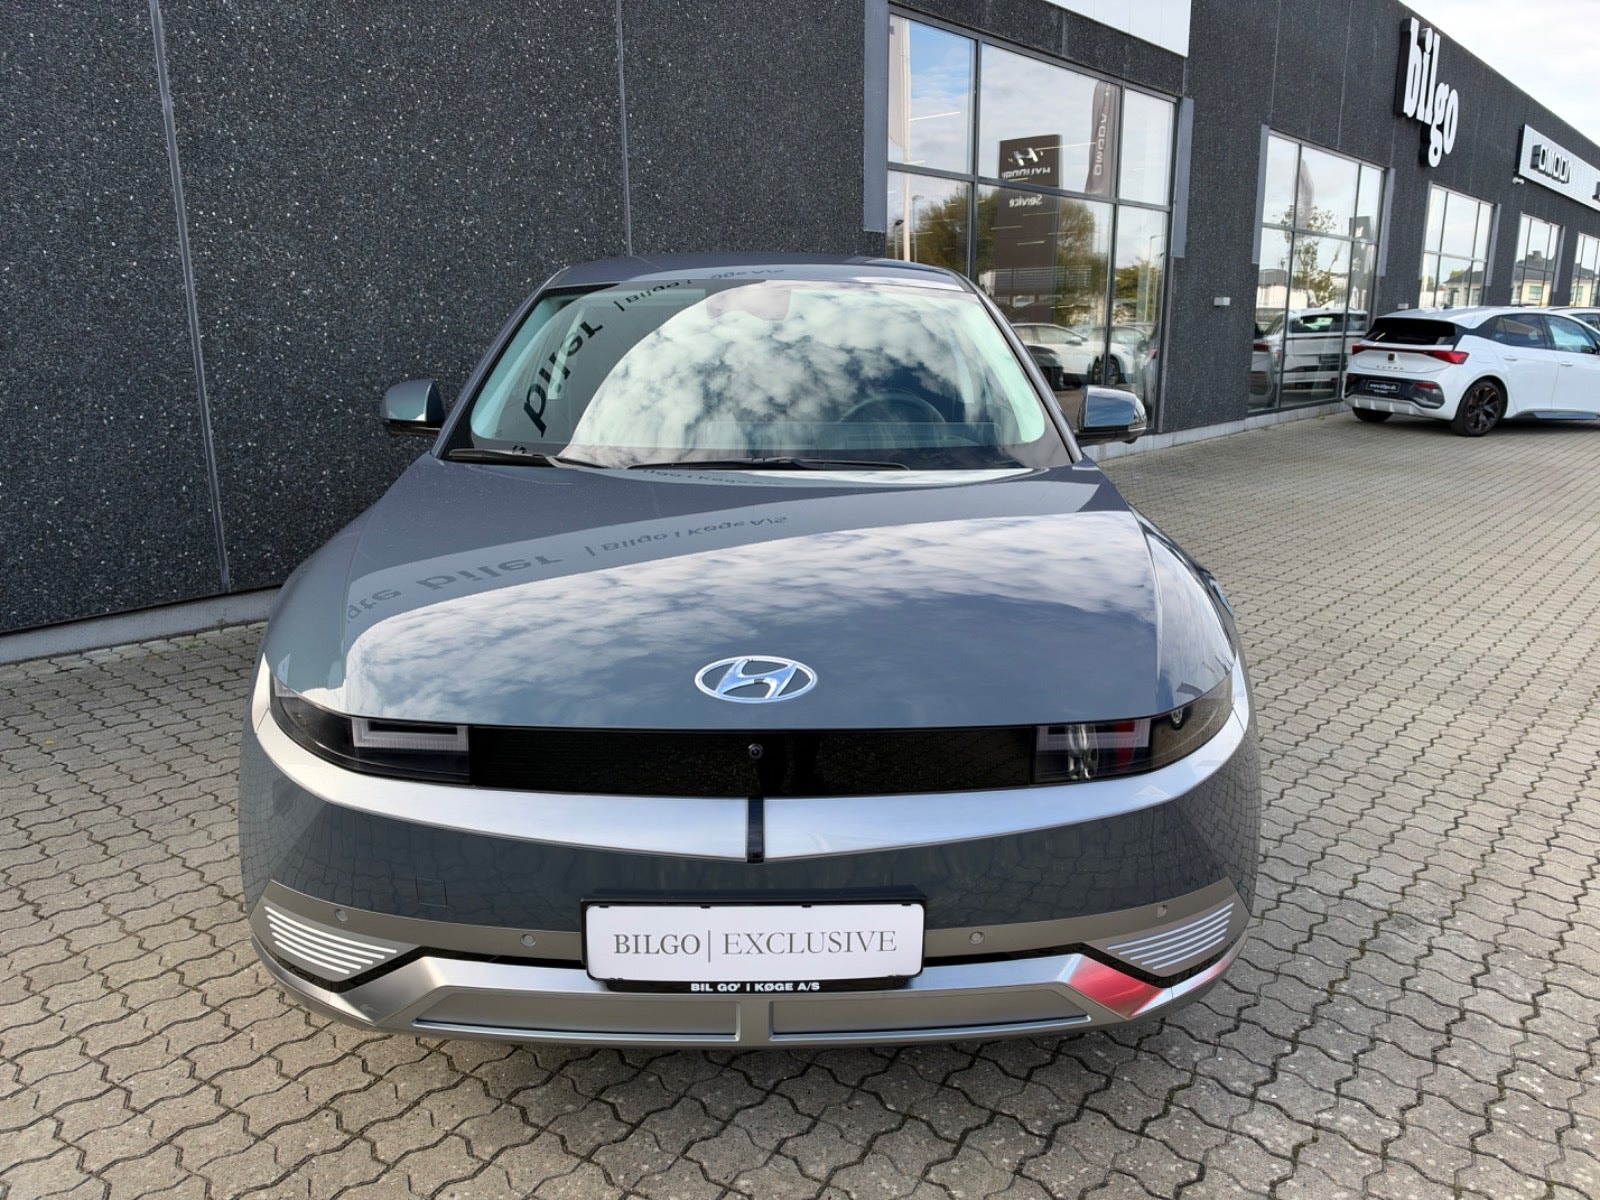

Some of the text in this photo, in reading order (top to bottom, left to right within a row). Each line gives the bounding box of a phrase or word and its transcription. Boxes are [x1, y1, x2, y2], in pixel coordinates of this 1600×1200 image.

[1403, 17, 1459, 168] bilgo
[613, 930, 898, 956] BILGO EXCLUSIVE
[690, 983, 713, 992] BIL
[754, 983, 794, 992] KØGE
[797, 982, 820, 991] A/S
